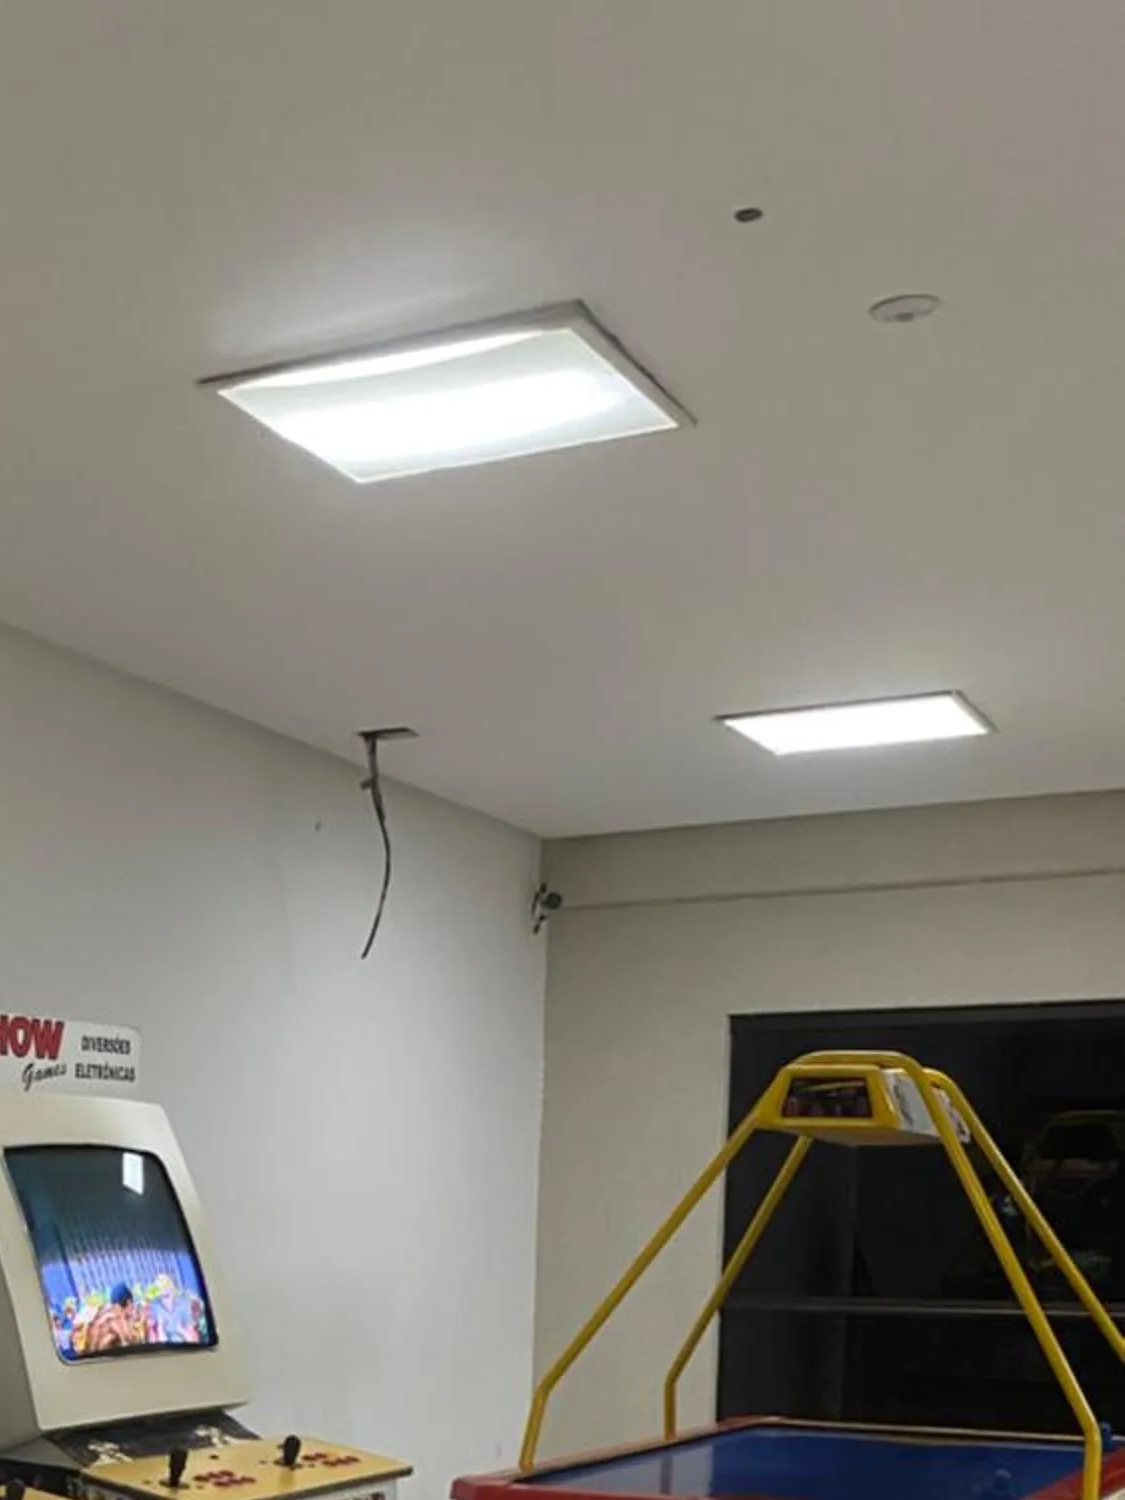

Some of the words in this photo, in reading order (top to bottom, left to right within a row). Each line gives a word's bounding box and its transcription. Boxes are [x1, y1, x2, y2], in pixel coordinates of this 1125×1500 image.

[81, 1033, 132, 1055] DIVERSÕES
[22, 1061, 68, 1092] Games
[74, 1059, 136, 1083] ELETRÔNICAS
